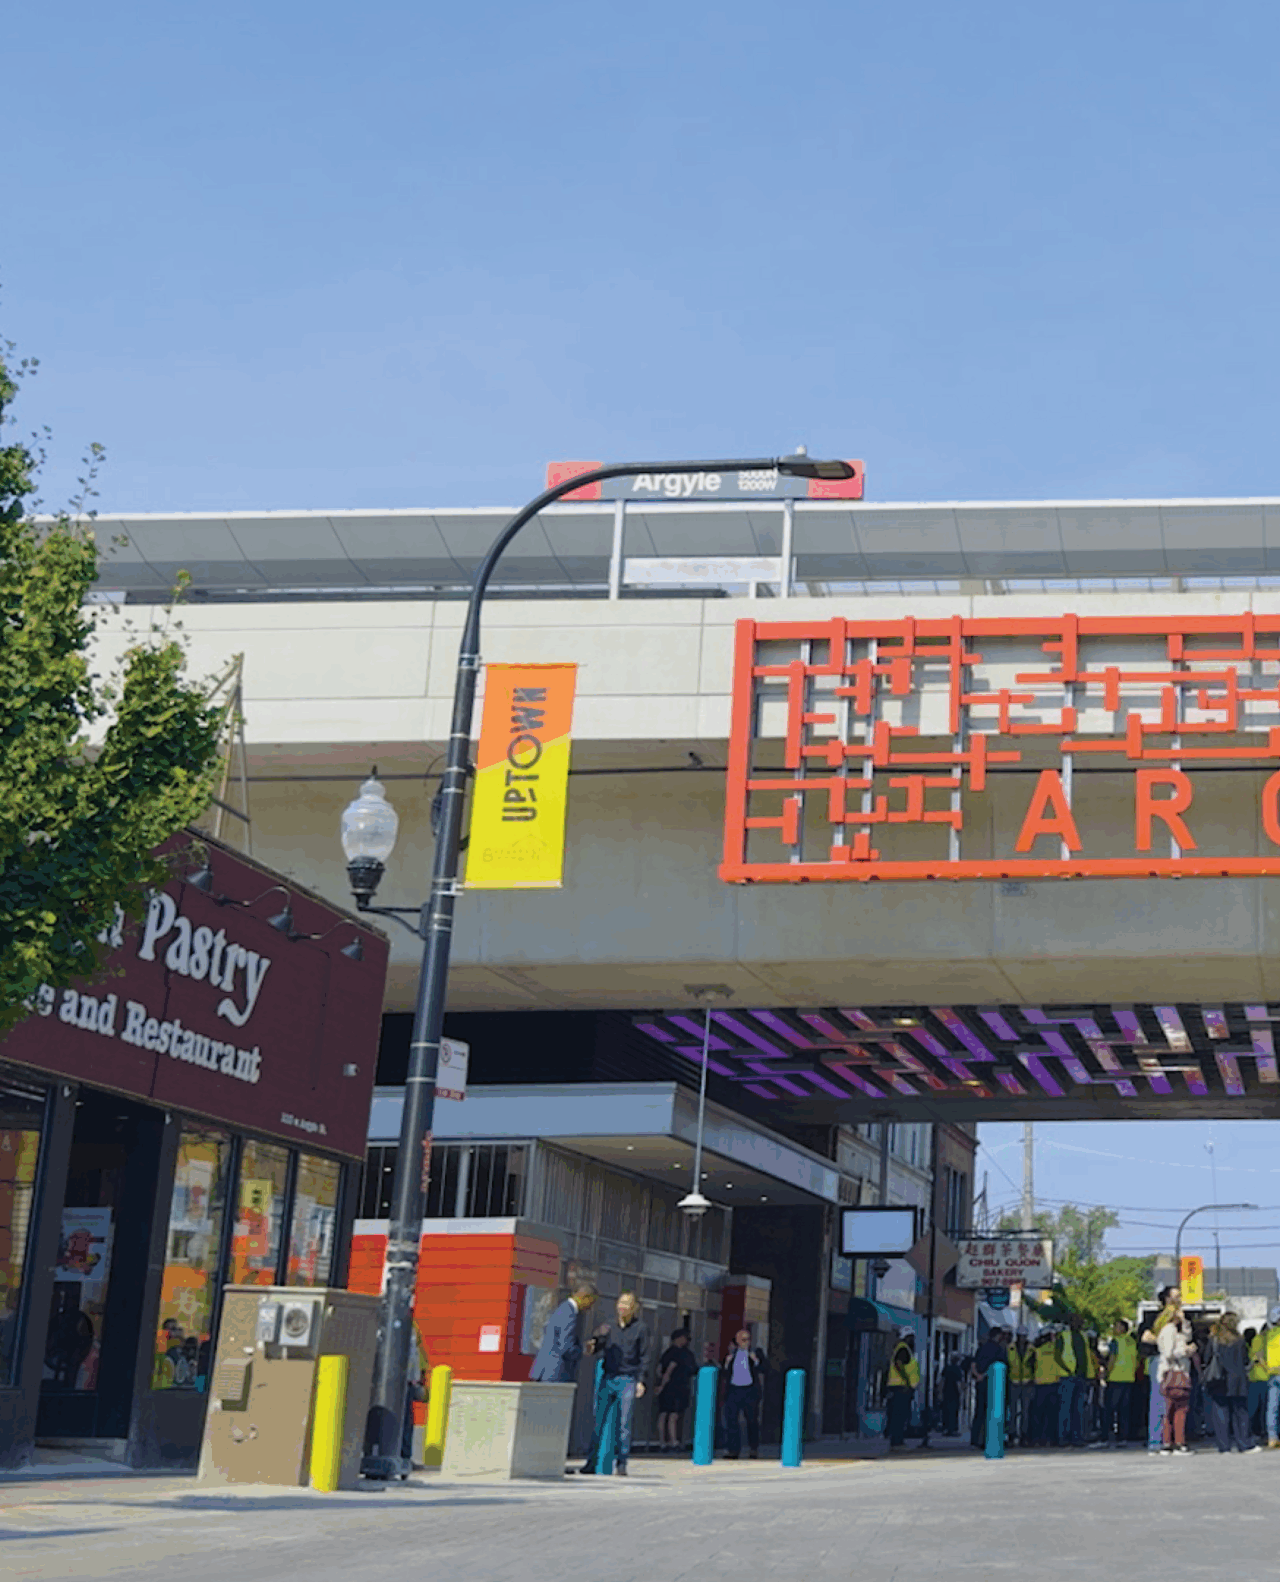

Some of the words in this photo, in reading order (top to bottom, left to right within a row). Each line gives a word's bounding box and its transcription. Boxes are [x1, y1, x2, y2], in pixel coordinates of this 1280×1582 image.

[632, 472, 721, 497] Argyle
[738, 480, 777, 491] 1200W
[501, 687, 548, 823] UPTOWN
[138, 888, 272, 1027] Pastry
[59, 988, 118, 1037] and
[121, 1000, 262, 1084] Restaurant
[969, 1258, 1000, 1268] CHIU
[1005, 1258, 1041, 1268] QUON
[982, 1268, 1024, 1277] BAKERY
